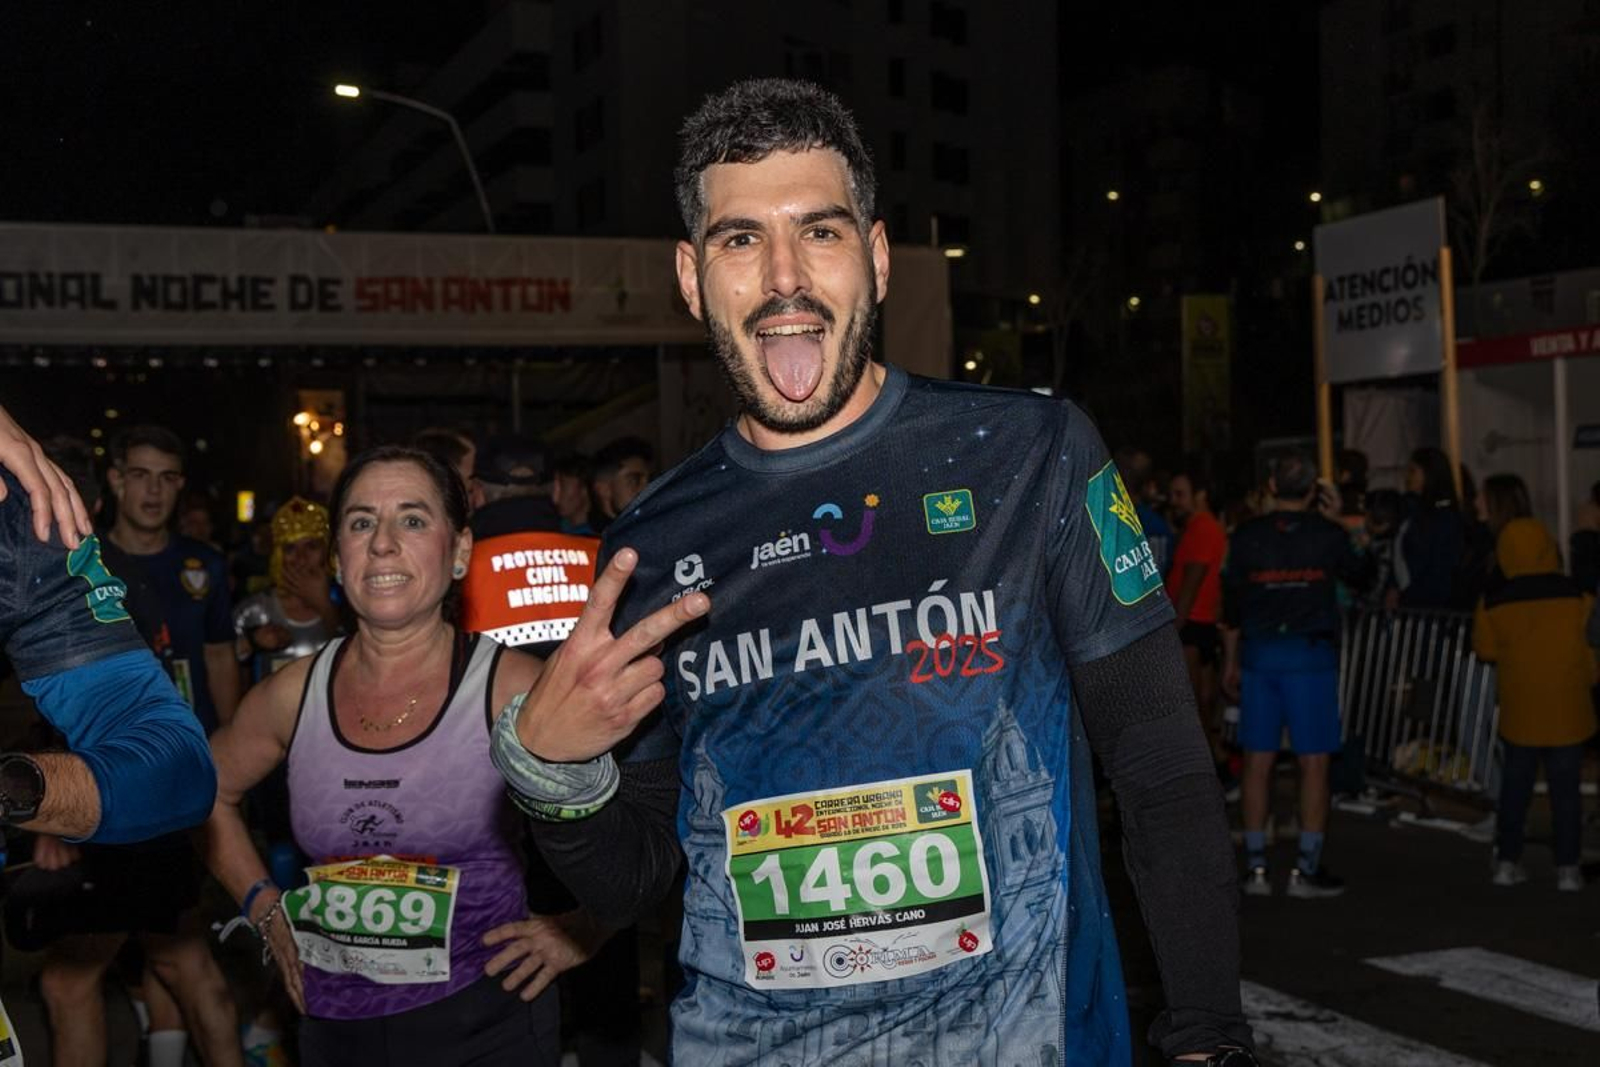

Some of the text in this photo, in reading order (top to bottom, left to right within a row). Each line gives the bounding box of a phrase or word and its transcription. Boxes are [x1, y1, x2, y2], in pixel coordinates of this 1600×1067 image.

[131, 274, 277, 311] NOCHE
[289, 275, 342, 312] DE
[355, 276, 434, 313] SAN
[1323, 254, 1437, 304] ATENCIÓN
[1337, 295, 1425, 333] MEDIOS
[491, 549, 589, 572] PROTECCION
[526, 565, 568, 585] CIVIL
[1115, 547, 1142, 574] CAJA
[678, 579, 999, 701] SAN ANTÓN
[905, 630, 1004, 684] 2025
[814, 790, 903, 810] CARRERA URBANA
[774, 803, 816, 838] 42
[816, 816, 849, 833] SAN
[751, 832, 961, 915] 1460
[294, 882, 436, 935] 2869
[795, 923, 819, 933] JUAN
[822, 918, 847, 932] JOSÉ
[895, 909, 926, 923] CANO
